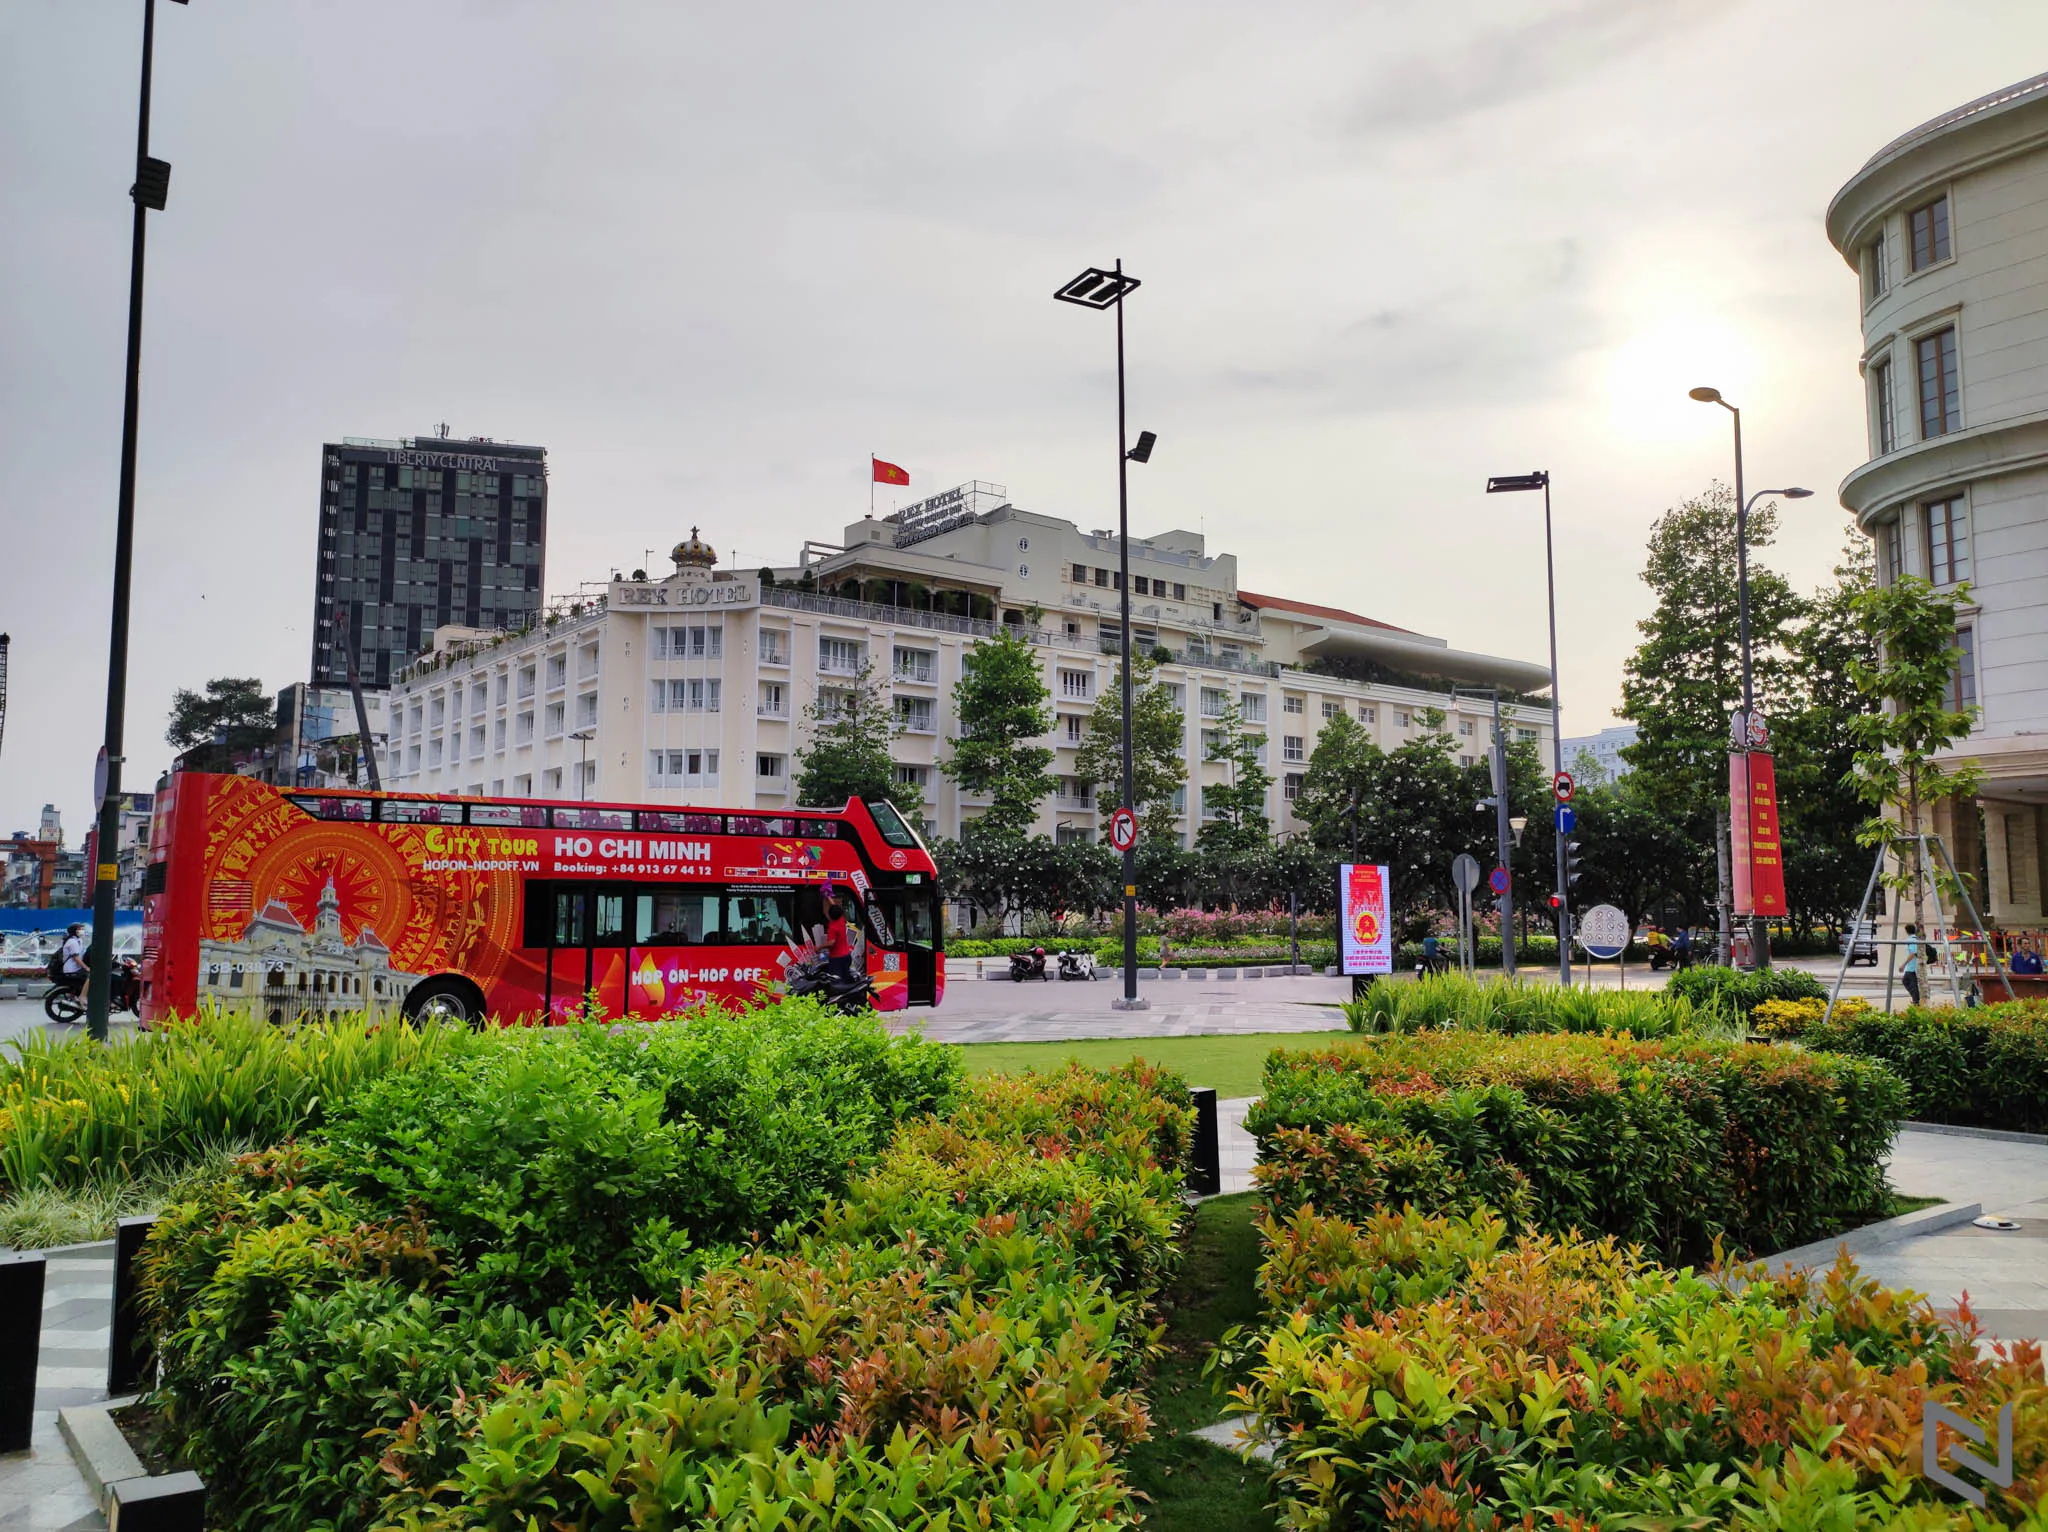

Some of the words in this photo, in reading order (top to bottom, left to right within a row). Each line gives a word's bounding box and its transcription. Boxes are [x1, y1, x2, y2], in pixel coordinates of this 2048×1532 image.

[387, 451, 438, 466] LIBERTY
[440, 455, 500, 472] CENTRAL
[925, 487, 964, 509] HOTEL
[619, 588, 667, 605] REX
[677, 585, 751, 605] HOTEL
[488, 838, 538, 856] TOUR
[554, 837, 592, 857] HO
[599, 839, 642, 859] CHI
[649, 840, 711, 861] MINH
[423, 860, 539, 871] HOPON-HOPOFF.VN
[554, 862, 607, 874] Booking:
[612, 863, 635, 873] +84
[638, 864, 660, 874] 913
[663, 865, 677, 875] 67
[680, 865, 694, 875] 44
[698, 866, 712, 875] 12
[632, 969, 663, 985] HOP
[668, 968, 729, 984] ON-HOP
[733, 967, 762, 982] OFF
